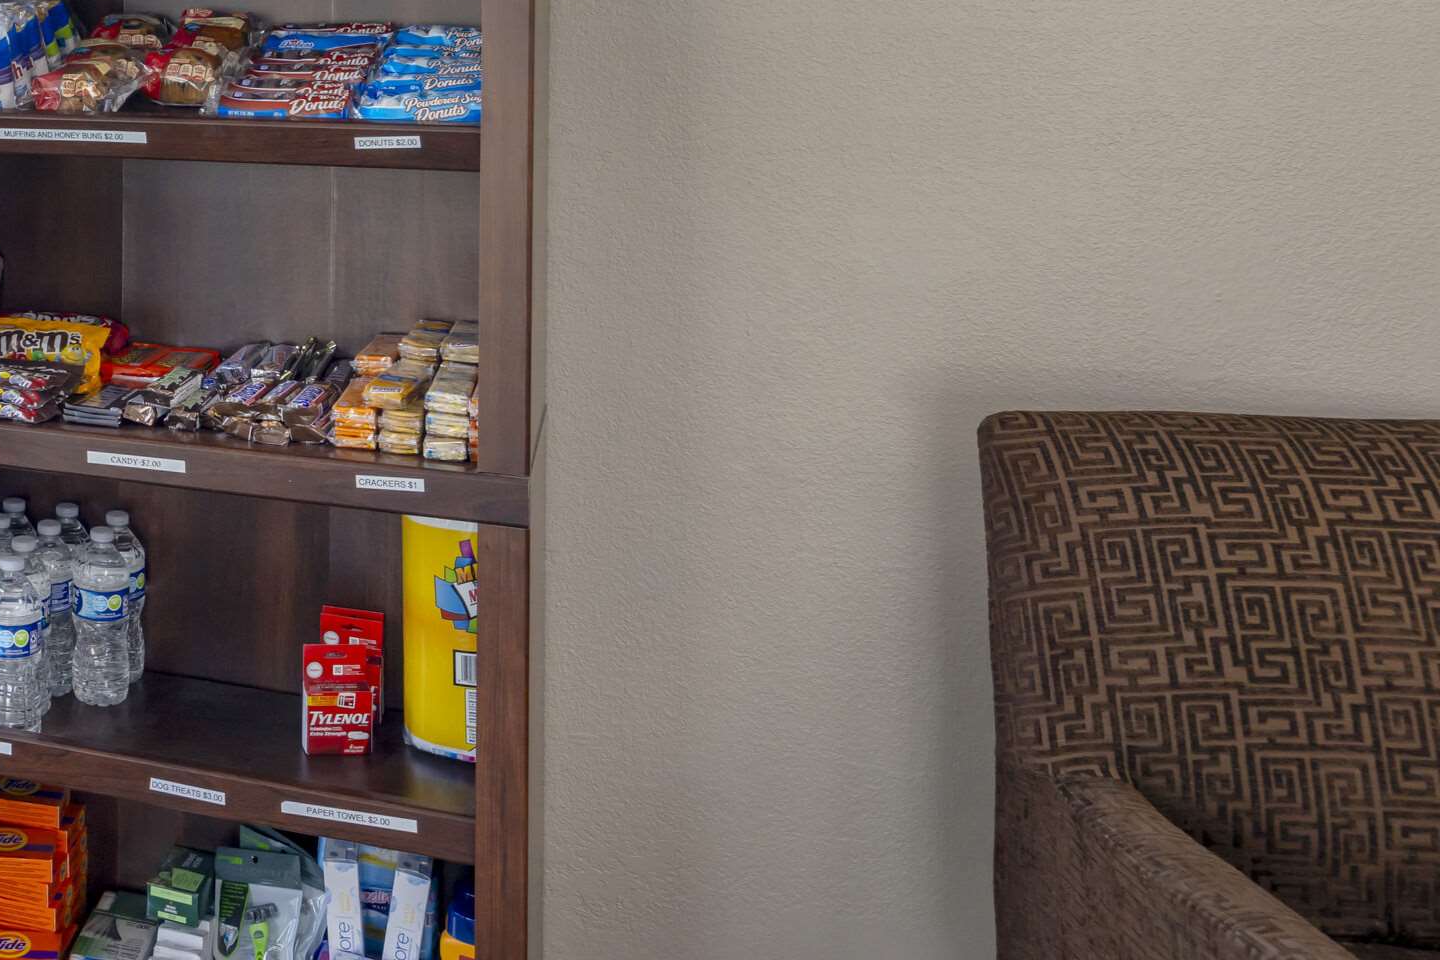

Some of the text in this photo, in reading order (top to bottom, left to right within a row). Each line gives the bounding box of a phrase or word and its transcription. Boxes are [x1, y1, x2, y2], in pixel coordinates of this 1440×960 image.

[424, 77, 474, 90] Donuts
[405, 95, 460, 112] Powdered
[415, 105, 467, 121] Donuts
[3, 130, 36, 138] MUFFINS
[37, 130, 54, 139] AND
[54, 131, 80, 139] HONEY
[359, 138, 394, 147] DONUTS
[359, 478, 405, 488] CRACKERS
[309, 711, 370, 726] TYLENOL
[152, 781, 169, 791] DOG
[171, 784, 201, 797] TREATS
[306, 806, 391, 826] PAPER TOWEL $2.00
